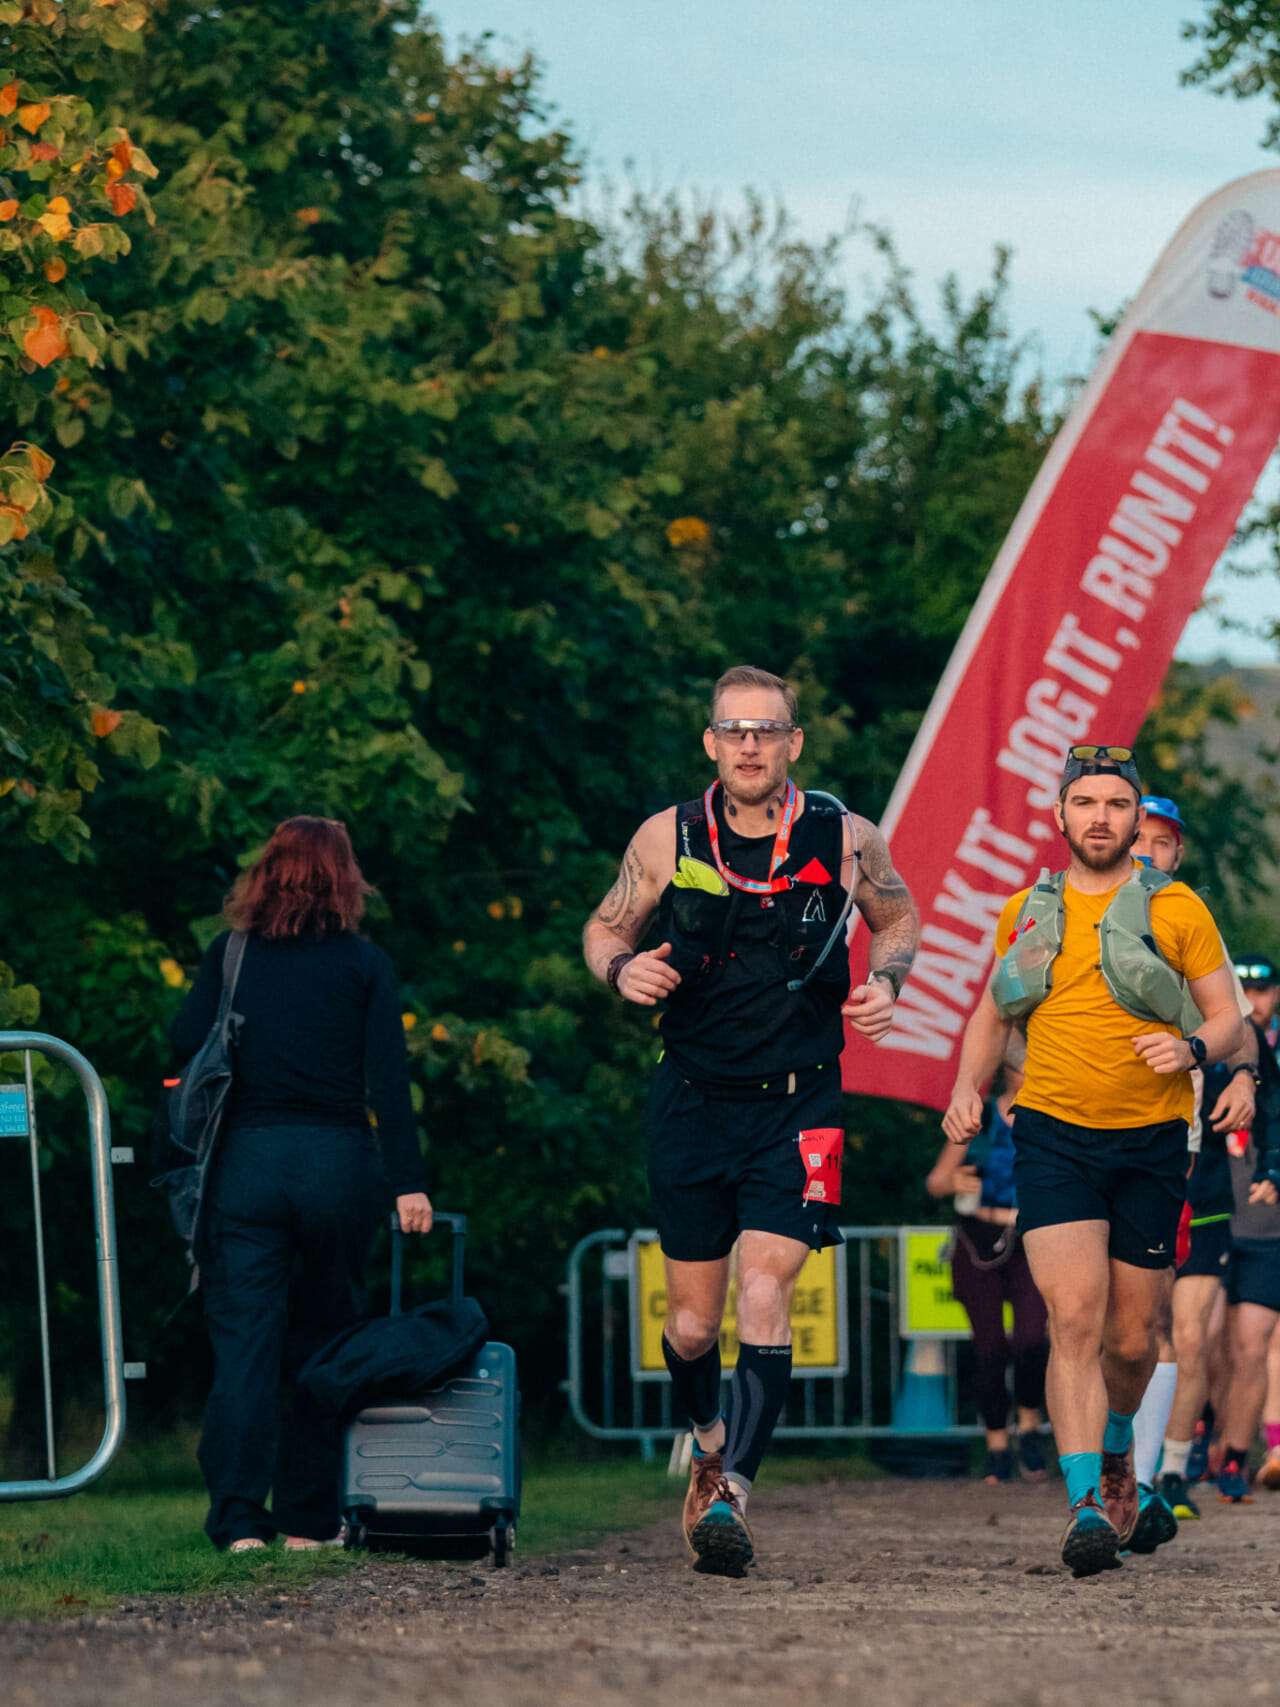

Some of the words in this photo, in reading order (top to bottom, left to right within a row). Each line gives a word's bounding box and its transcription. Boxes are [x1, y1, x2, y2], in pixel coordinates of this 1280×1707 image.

[1144, 397, 1235, 494] IT!
[1079, 469, 1197, 622] RUN
[1043, 612, 1141, 696] IT,
[995, 678, 1098, 810] JOG
[954, 807, 1053, 887] IT,
[876, 868, 1012, 1061] WALK
